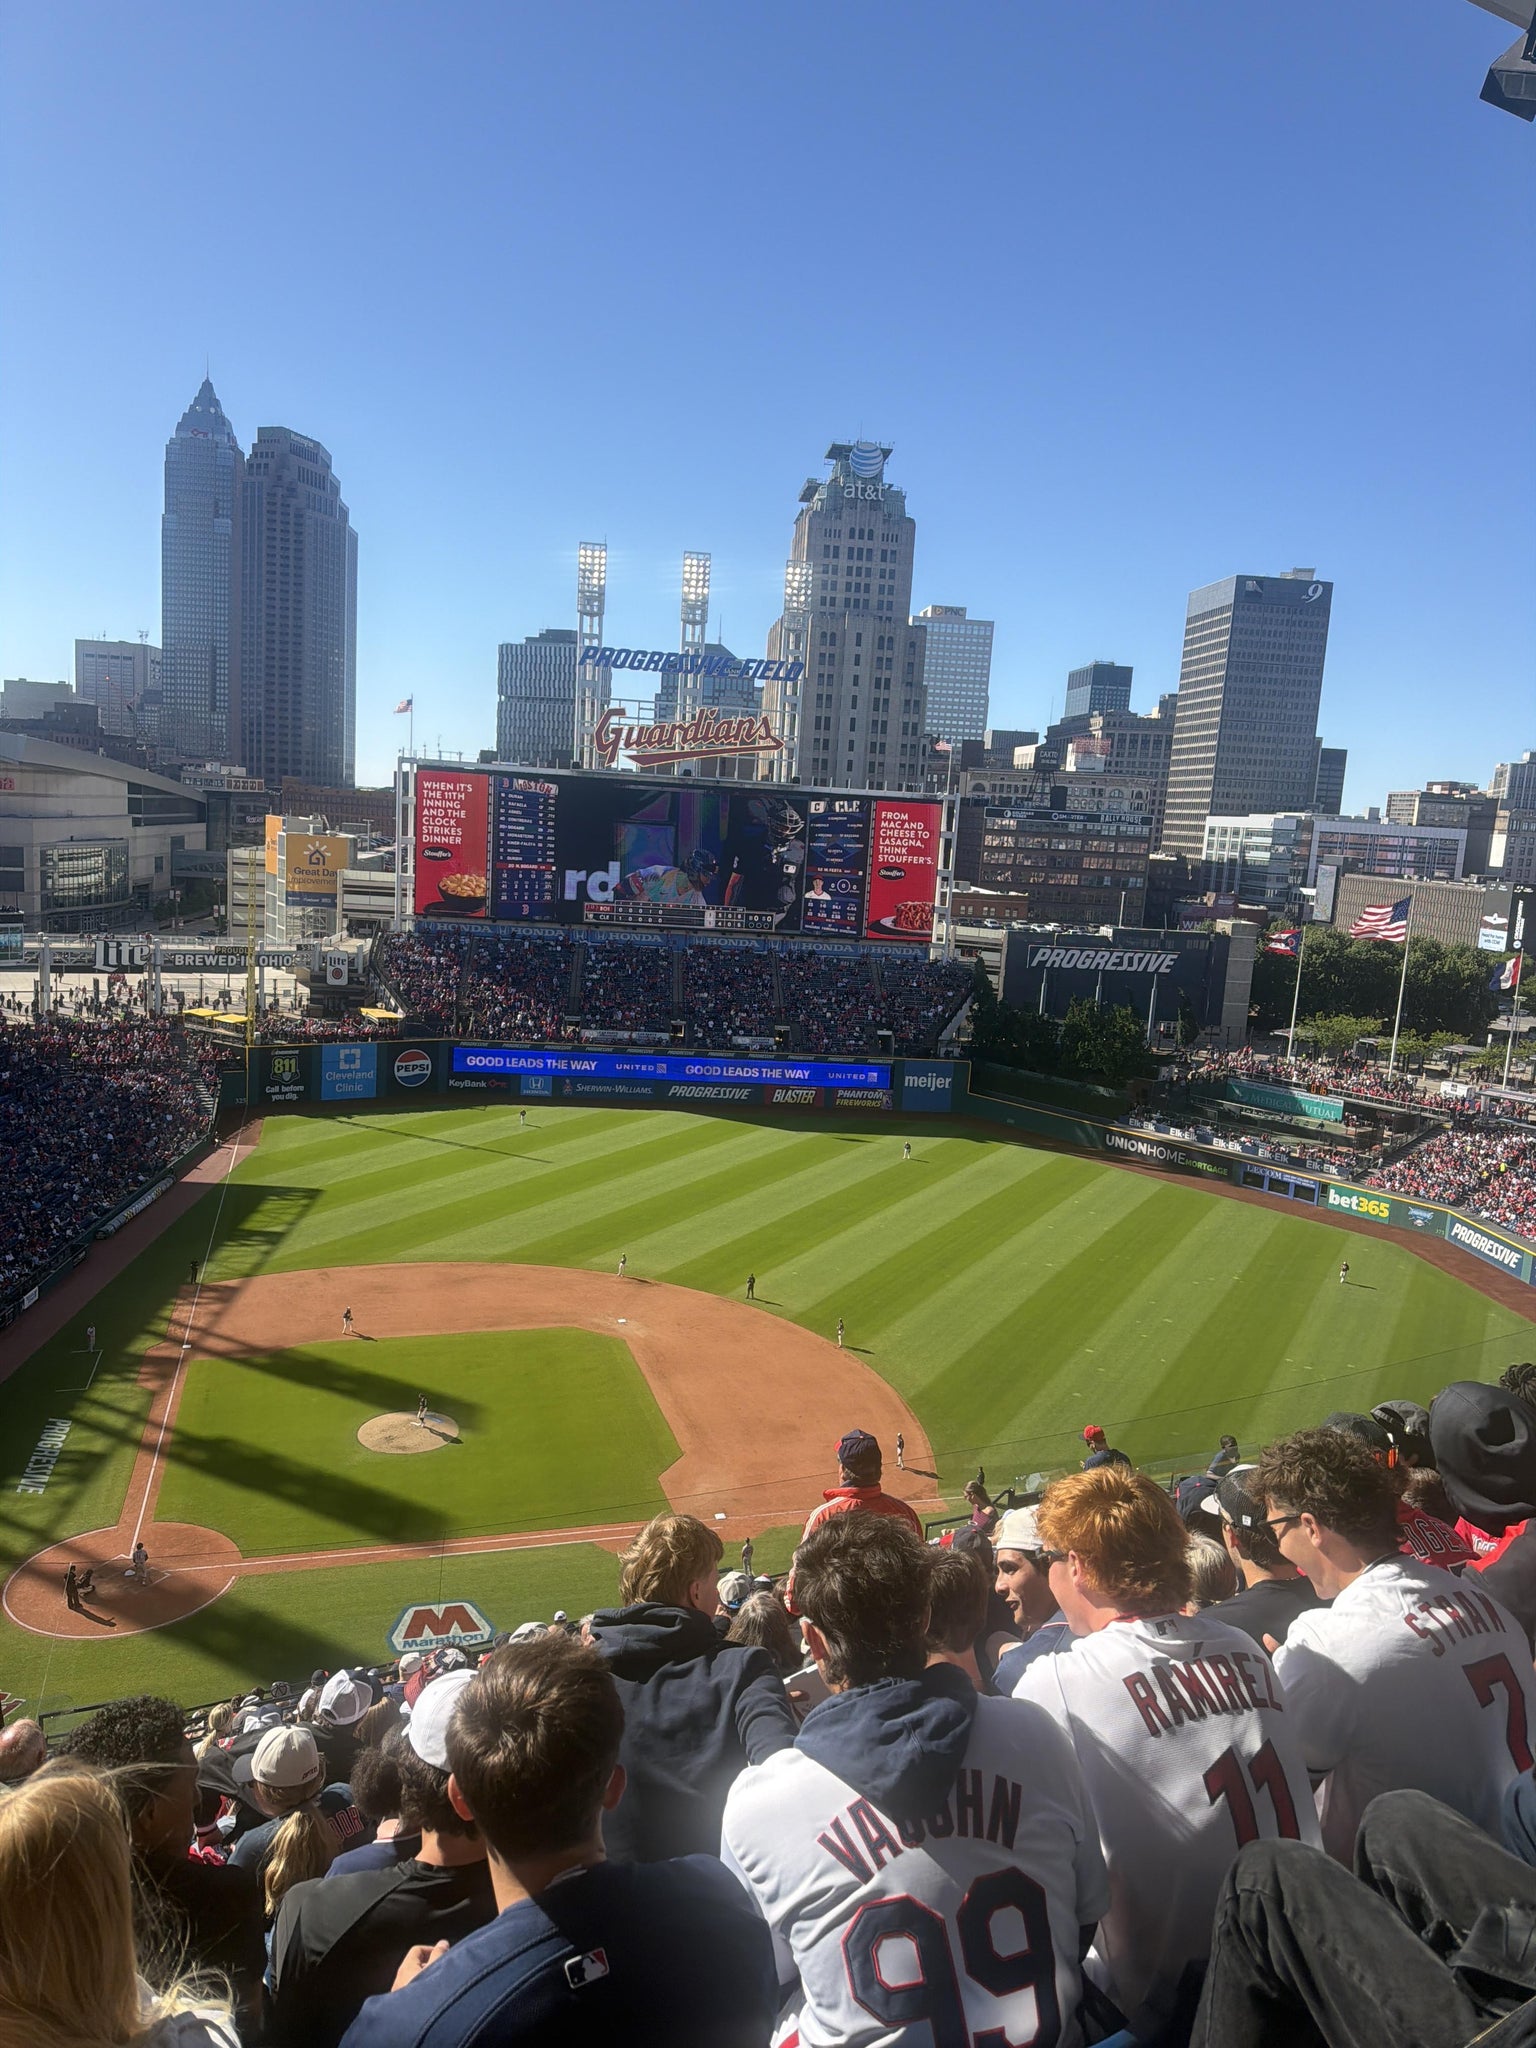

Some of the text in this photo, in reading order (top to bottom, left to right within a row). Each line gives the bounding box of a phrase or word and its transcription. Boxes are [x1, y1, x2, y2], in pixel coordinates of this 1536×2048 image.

[844, 480, 885, 501] at&t
[1305, 583, 1324, 603] 9
[578, 645, 805, 682] PROGRESSIVE FIELD
[594, 706, 785, 768] Guardians
[422, 780, 473, 792] WHEN IT'S
[422, 790, 465, 801] THE 11TH
[422, 799, 461, 809] INNING
[422, 808, 467, 818] AND THE
[881, 811, 909, 820] FROM
[422, 817, 457, 827] CLOCK
[880, 820, 924, 830] MAC AND
[422, 826, 462, 836] STRIKES
[879, 829, 930, 839] CHEESE TO
[422, 835, 462, 845] DINNER
[879, 837, 925, 849] LASAGNA,
[423, 849, 452, 858] Stouffer's
[878, 846, 908, 855] THINK
[878, 854, 935, 865] STOUFFER'S.
[294, 866, 320, 876] Great
[879, 869, 905, 877] Stouffer's
[436, 922, 493, 934] HONDA
[512, 925, 566, 937] HONDA
[608, 932, 663, 943] HONDA
[707, 937, 760, 948] HONDA
[215, 946, 255, 954] PROUDL
[801, 942, 854, 953] HONDA
[870, 946, 923, 956] HONDA
[92, 940, 150, 973] Lite
[174, 954, 237, 966] BREWED
[259, 955, 293, 967] OHIO
[329, 956, 347, 967] Lite
[1030, 948, 1180, 974] PROGRESSIVE
[273, 1058, 296, 1074] 811
[396, 1063, 429, 1073] PEPSI
[466, 1055, 655, 1071] GOOD LEADS THE WAY UNITED
[325, 1070, 374, 1081] Cleveland
[685, 1065, 866, 1080] GOOD LEADS THE WAY UNITED
[448, 1079, 488, 1089] KeyBank
[904, 1072, 952, 1092] meijer
[265, 1084, 305, 1094] Call before
[335, 1083, 364, 1093] Clinic
[668, 1085, 752, 1100] PROGRESSIVE
[271, 1093, 299, 1102] you dig.
[772, 1089, 817, 1104] BLASTER
[836, 1089, 884, 1100] PHANTOM
[835, 1098, 882, 1108] FIREWORKS
[1251, 1093, 1336, 1119] MEDICAL MUTUAL
[1105, 1133, 1187, 1166] UNIONHOME
[1185, 1158, 1229, 1176] MORTGAGE
[1247, 1164, 1282, 1180] LECOM
[1328, 1188, 1390, 1218] bet365
[1450, 1222, 1523, 1269] PROGRESSIVE
[16, 1417, 73, 1496] PROGRESSIVE
[403, 1633, 485, 1649] Marathon
[1461, 1652, 1535, 1775] 7
[1202, 1737, 1301, 1850] 11
[840, 1865, 1063, 2048] 99
